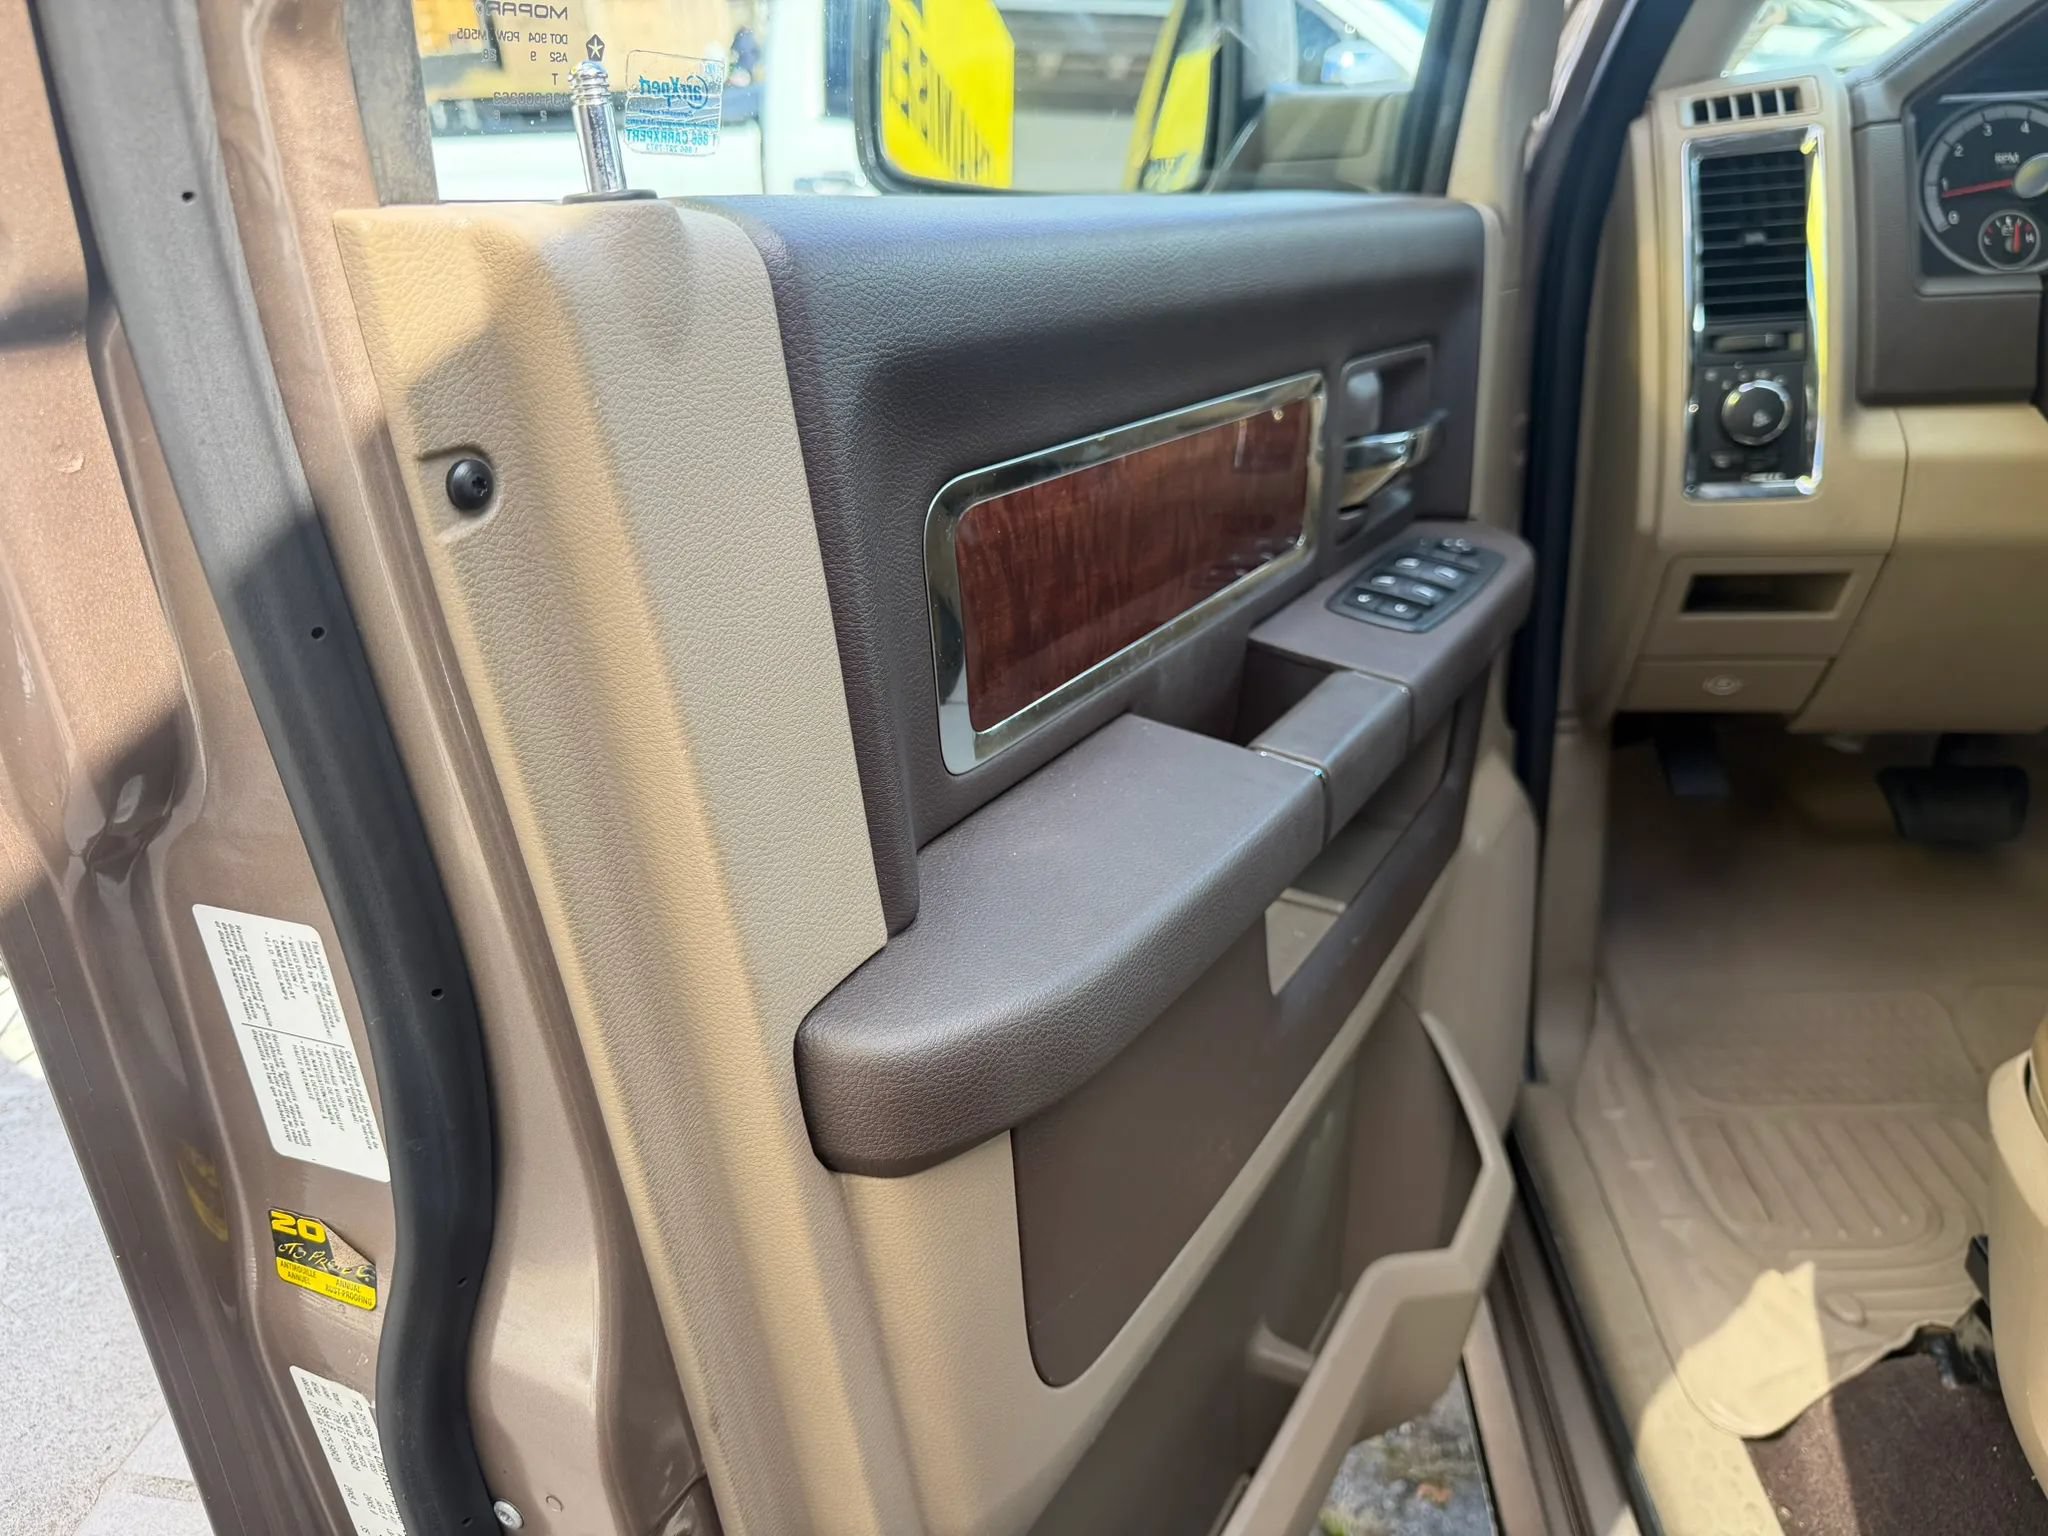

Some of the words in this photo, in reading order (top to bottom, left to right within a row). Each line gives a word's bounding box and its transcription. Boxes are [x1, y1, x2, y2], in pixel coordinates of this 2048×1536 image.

[1983, 124, 1993, 137] 3
[2020, 120, 2030, 134] 4
[1954, 143, 1964, 157] 2
[271, 1210, 326, 1244] 20
